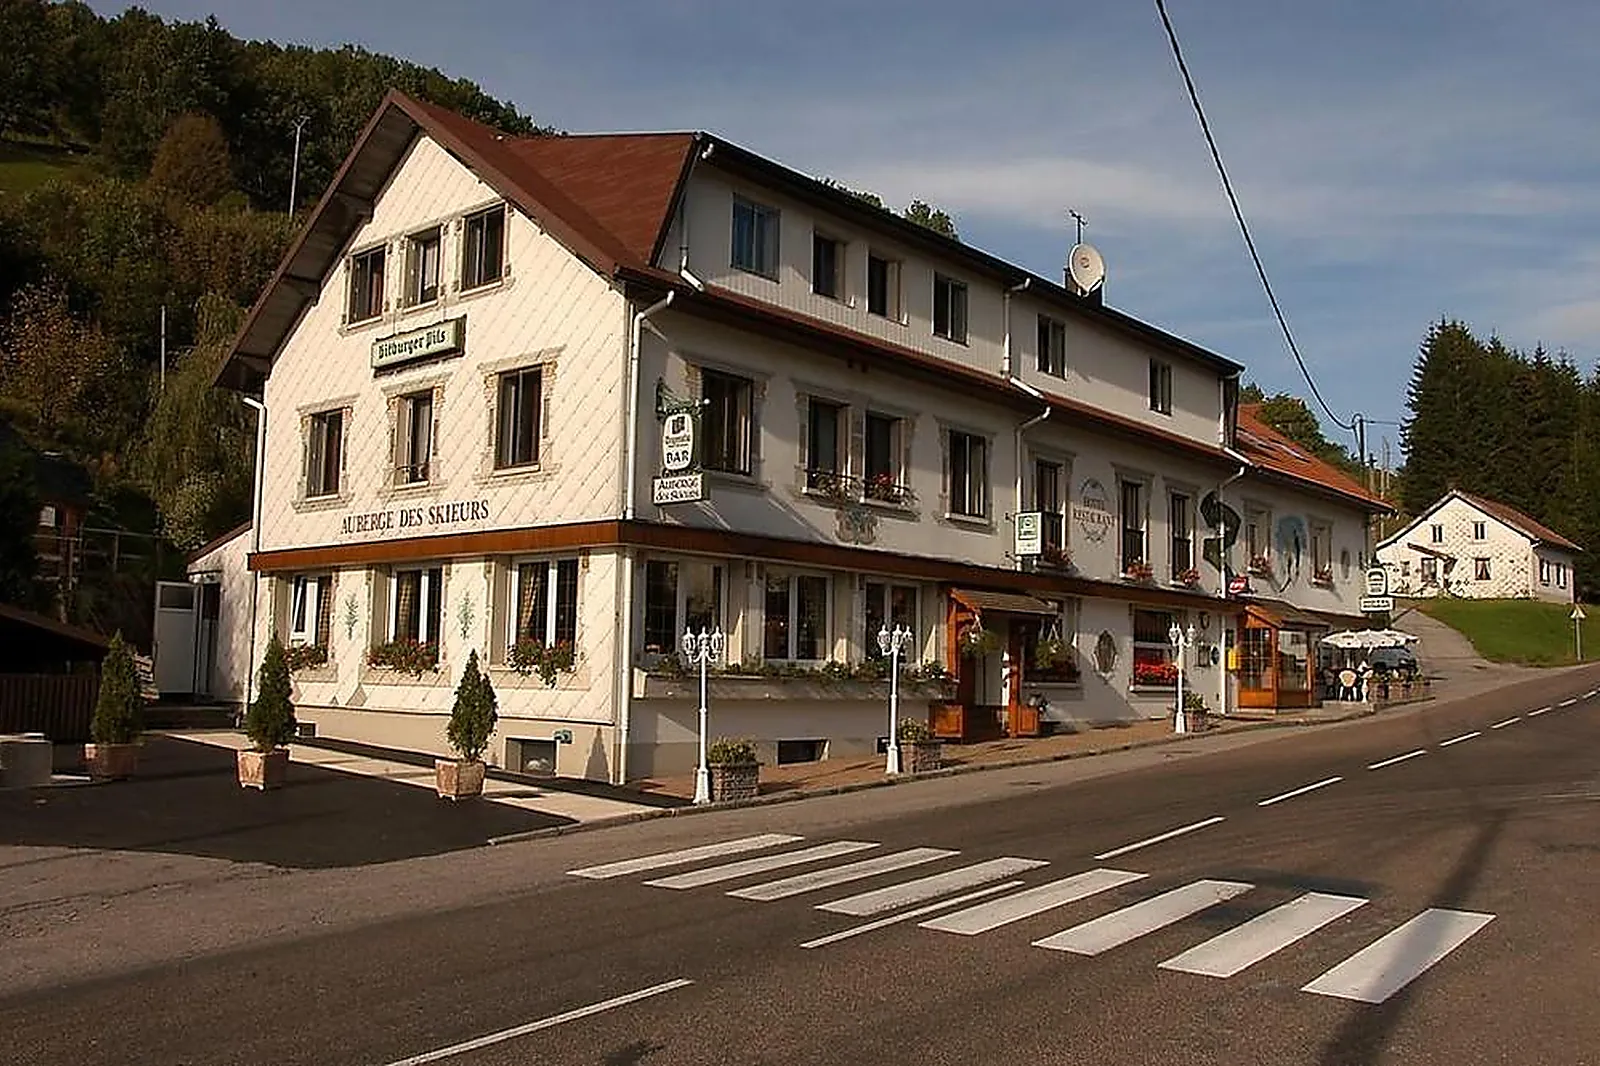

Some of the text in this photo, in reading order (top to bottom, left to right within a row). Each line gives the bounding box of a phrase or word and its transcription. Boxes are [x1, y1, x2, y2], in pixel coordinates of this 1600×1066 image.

[378, 328, 446, 360] Bitburger Pils
[666, 450, 689, 464] BAR
[340, 499, 490, 535] AUBERGE DES SKIEURS
